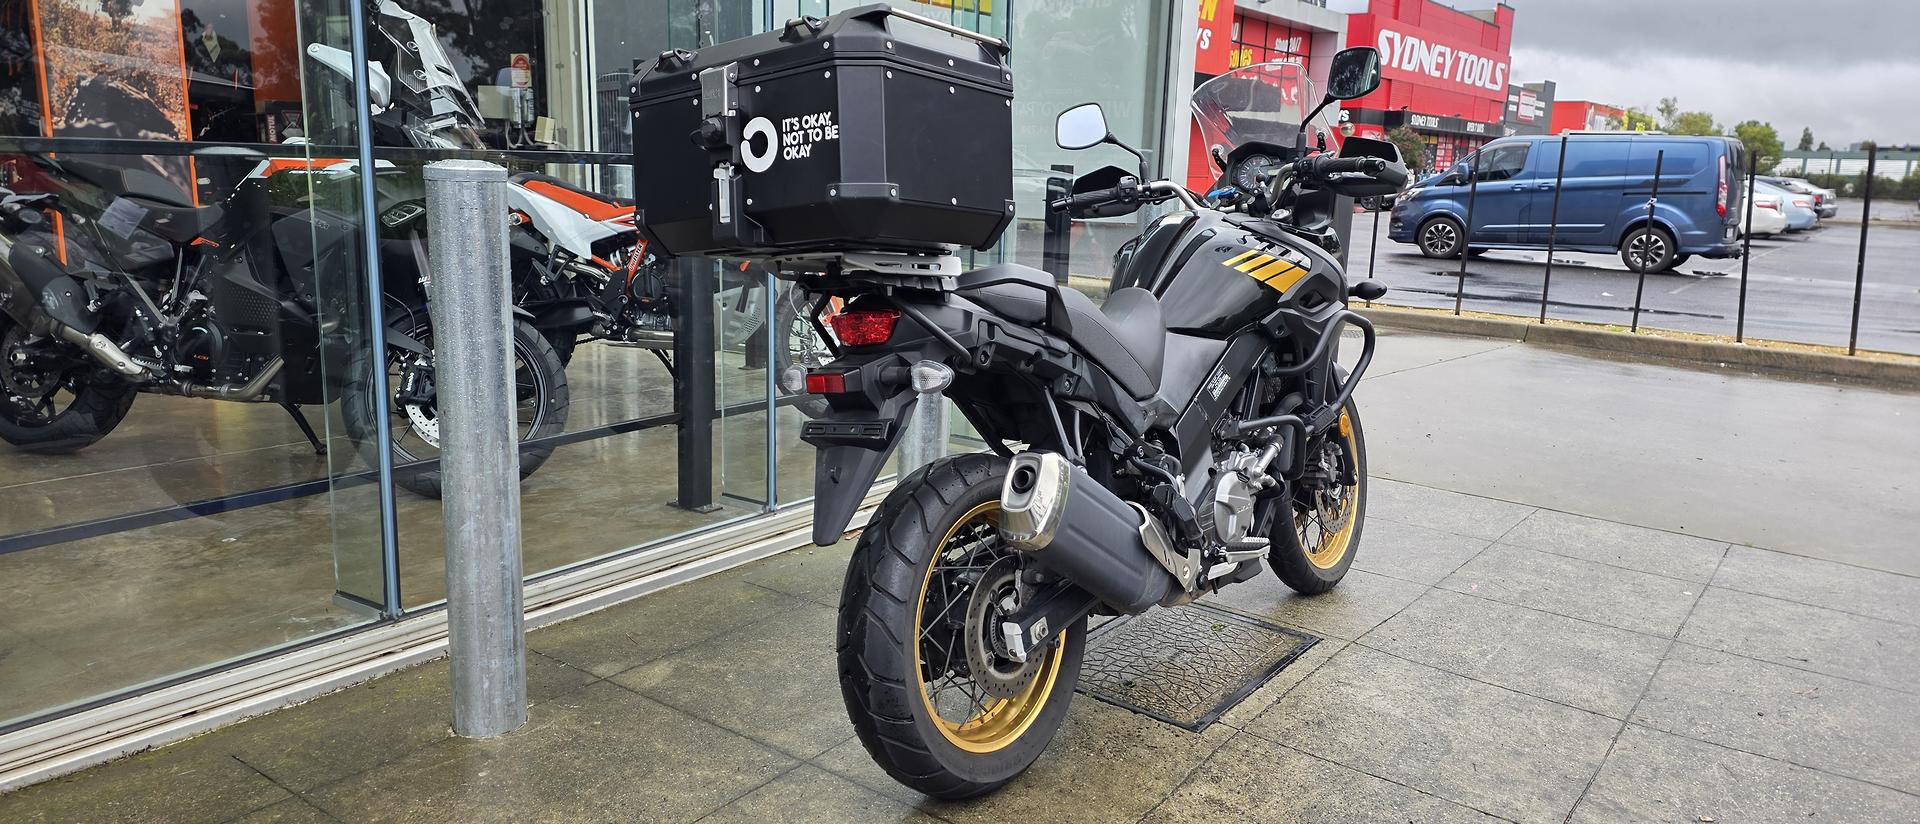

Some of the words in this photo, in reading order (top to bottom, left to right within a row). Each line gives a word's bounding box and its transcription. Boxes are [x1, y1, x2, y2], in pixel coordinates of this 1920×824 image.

[1378, 28, 1457, 80] SYDNEY
[1456, 51, 1505, 91] TOOLS
[267, 116, 277, 142] MOTUL
[782, 117, 800, 132] IT'S
[802, 111, 832, 129] OKAY,
[783, 130, 804, 147] NOT
[807, 128, 822, 142] TO
[824, 125, 839, 140] BE
[783, 143, 812, 160] OKAY
